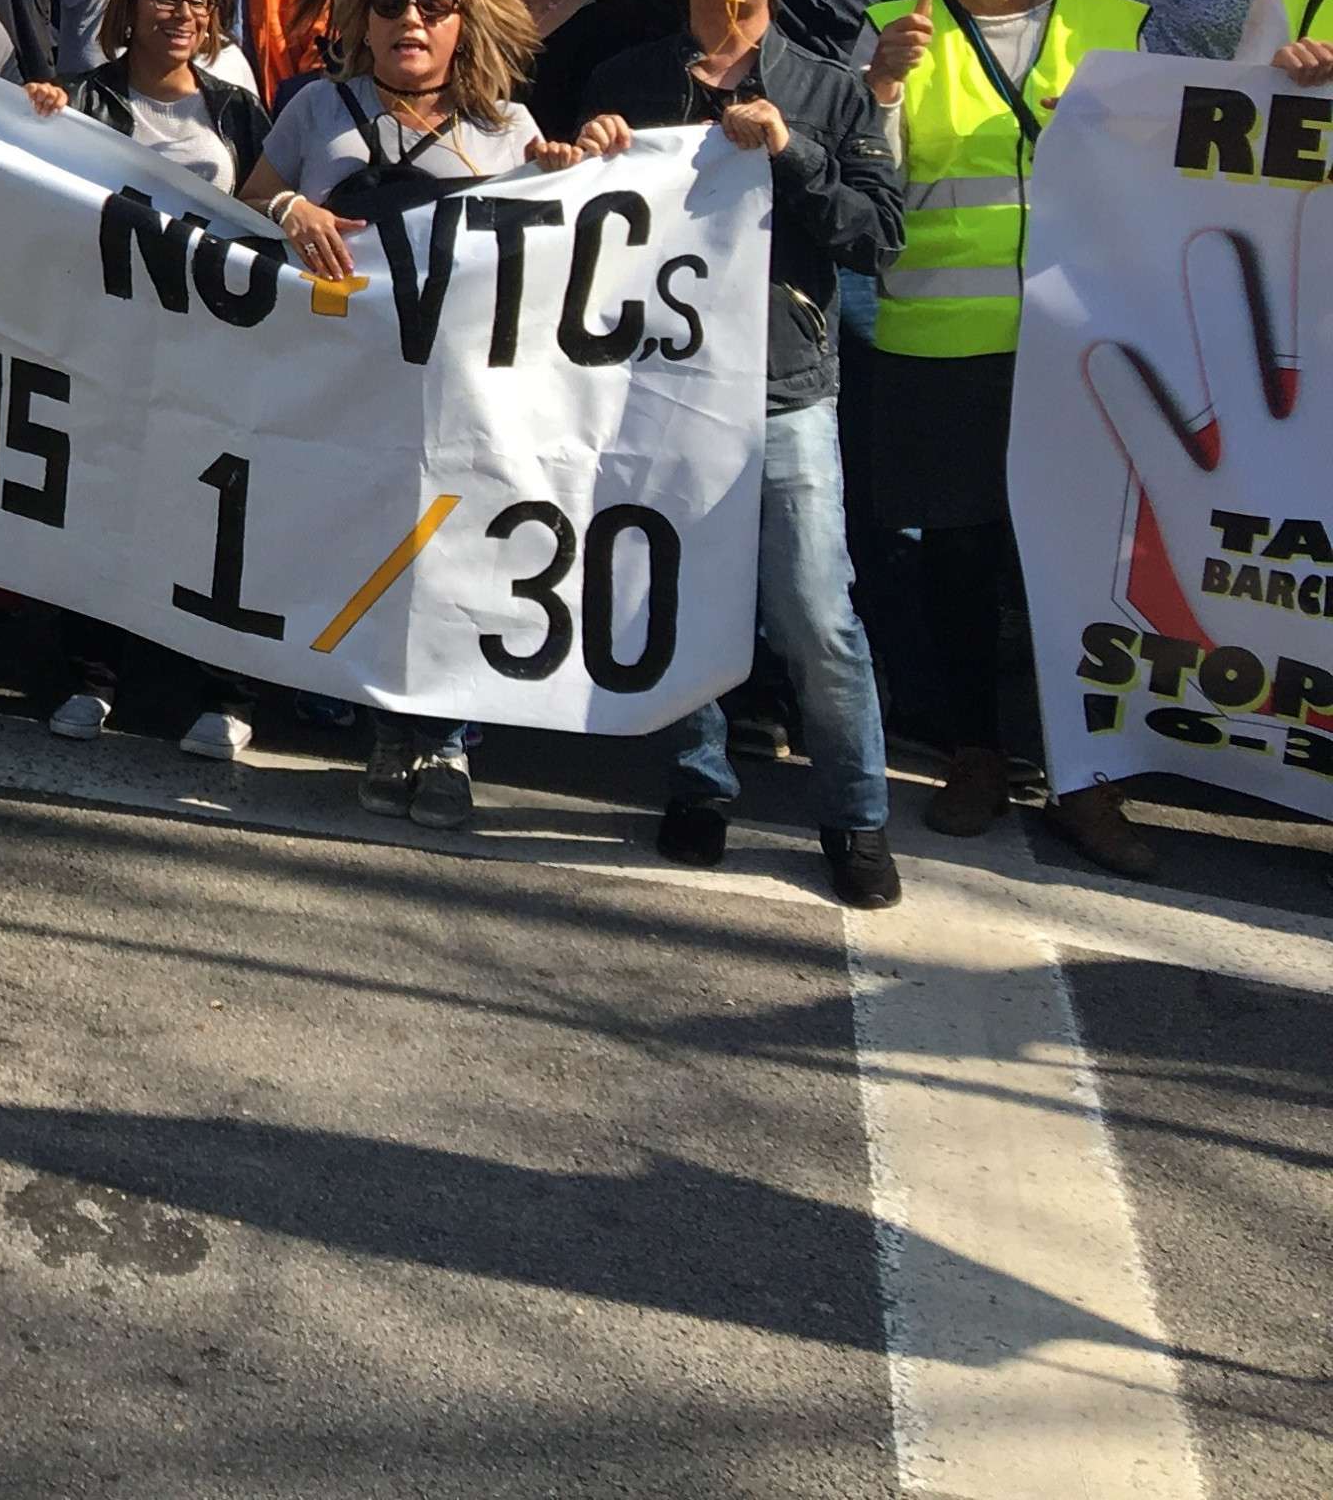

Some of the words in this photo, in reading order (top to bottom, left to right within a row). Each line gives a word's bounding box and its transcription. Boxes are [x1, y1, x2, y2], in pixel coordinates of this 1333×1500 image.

[1174, 86, 1333, 182] RE
[99, 185, 288, 328] NO
[1076, 621, 1333, 719] STOP
